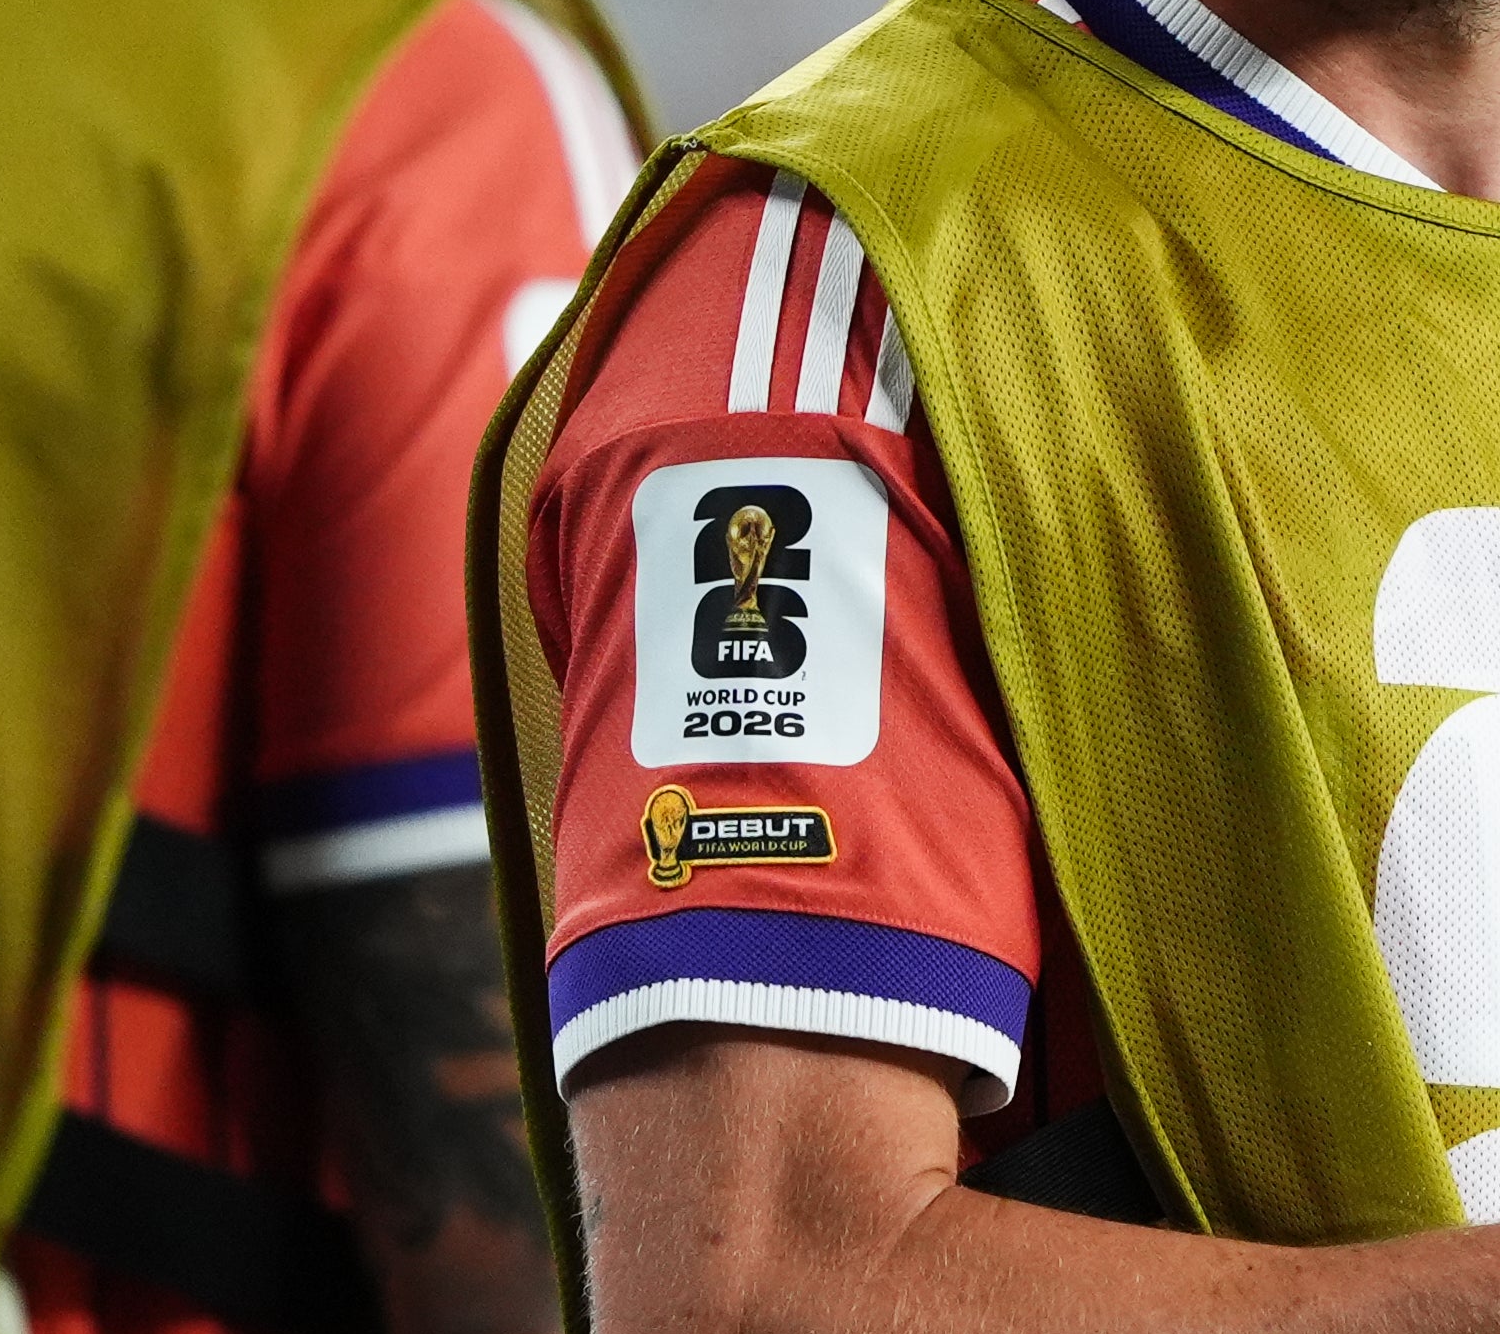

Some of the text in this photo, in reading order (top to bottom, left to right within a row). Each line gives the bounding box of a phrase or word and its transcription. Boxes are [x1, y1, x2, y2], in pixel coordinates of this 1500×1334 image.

[718, 640, 774, 662] FIFA
[686, 688, 806, 707] WORLD CUP
[684, 710, 806, 738] 2026
[691, 818, 815, 840] DEBUT
[698, 840, 808, 854] FIFA WORLD CUP
